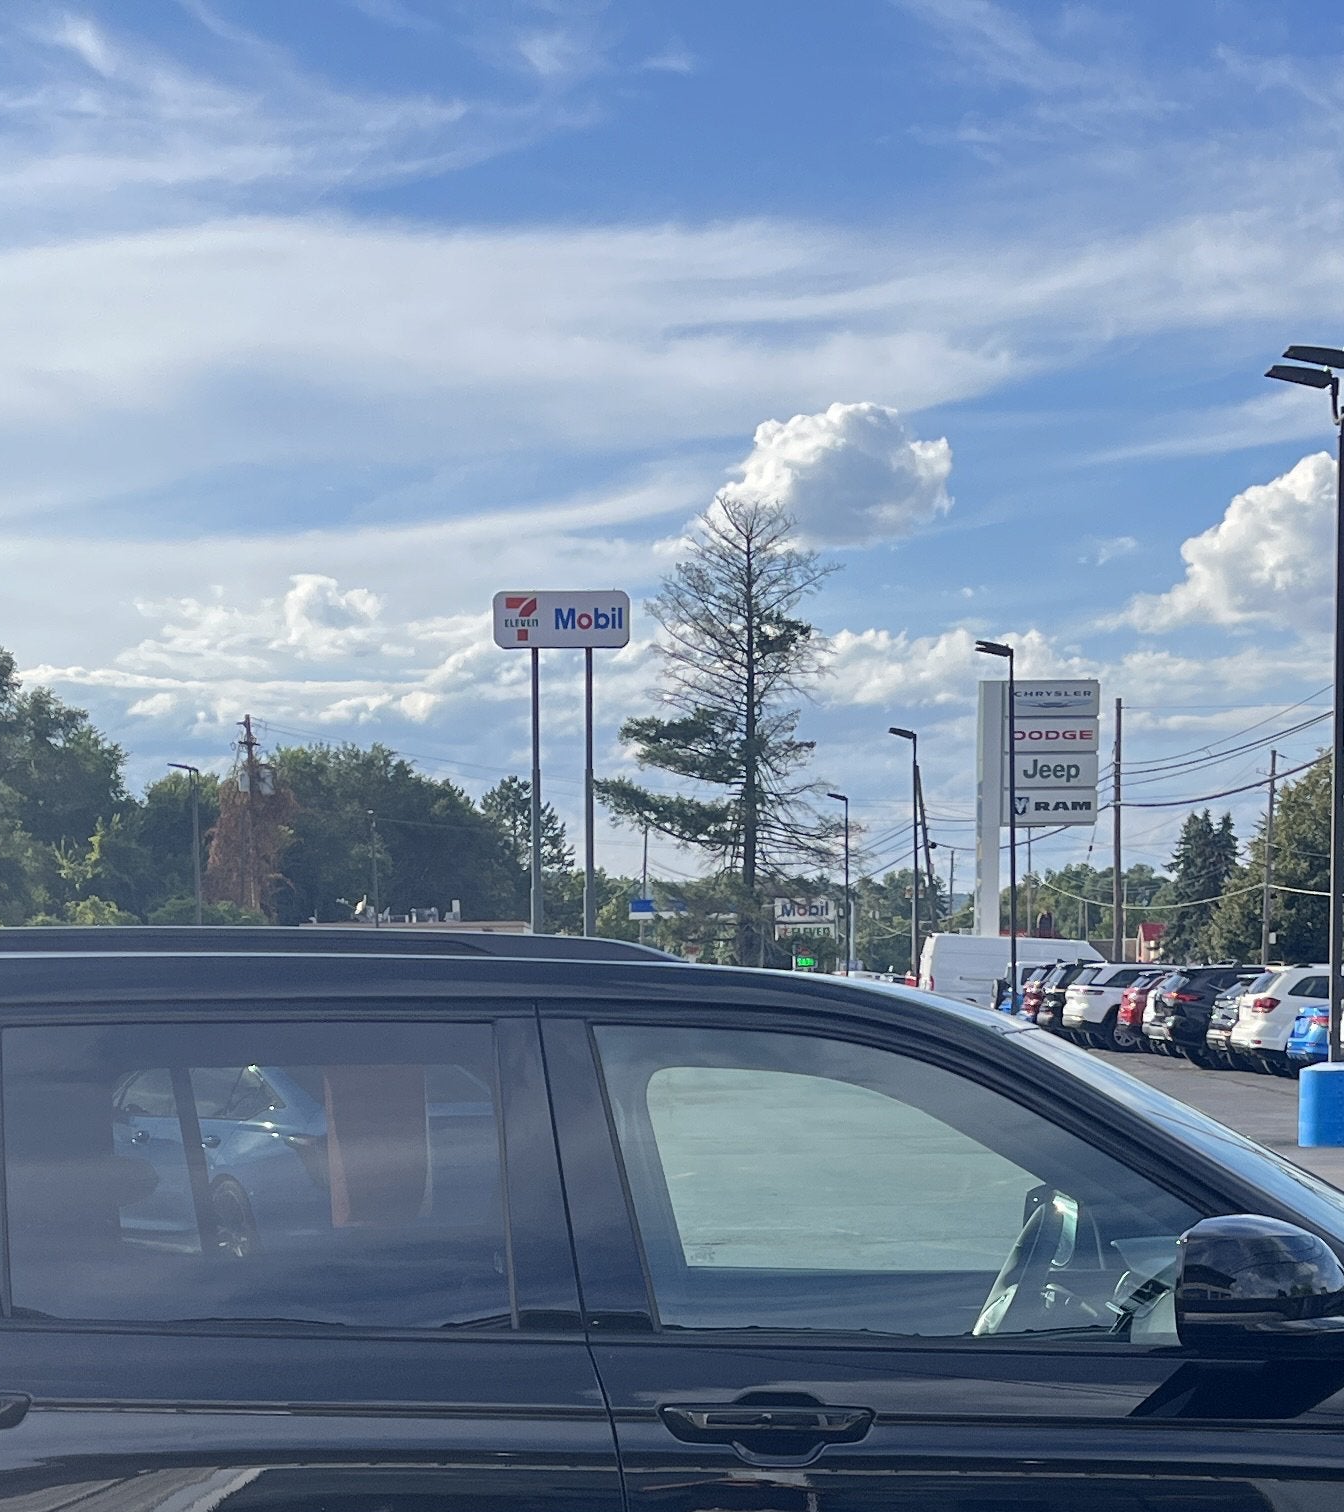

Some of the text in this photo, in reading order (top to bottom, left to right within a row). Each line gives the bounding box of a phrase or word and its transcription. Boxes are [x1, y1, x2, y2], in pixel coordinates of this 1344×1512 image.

[554, 607, 622, 630] Mobil
[1014, 690, 1092, 698] CHRYSLER
[1014, 730, 1093, 741] DODGE
[1023, 758, 1080, 783] Jeep
[1034, 801, 1091, 812] RAM
[782, 901, 829, 917] Mobil
